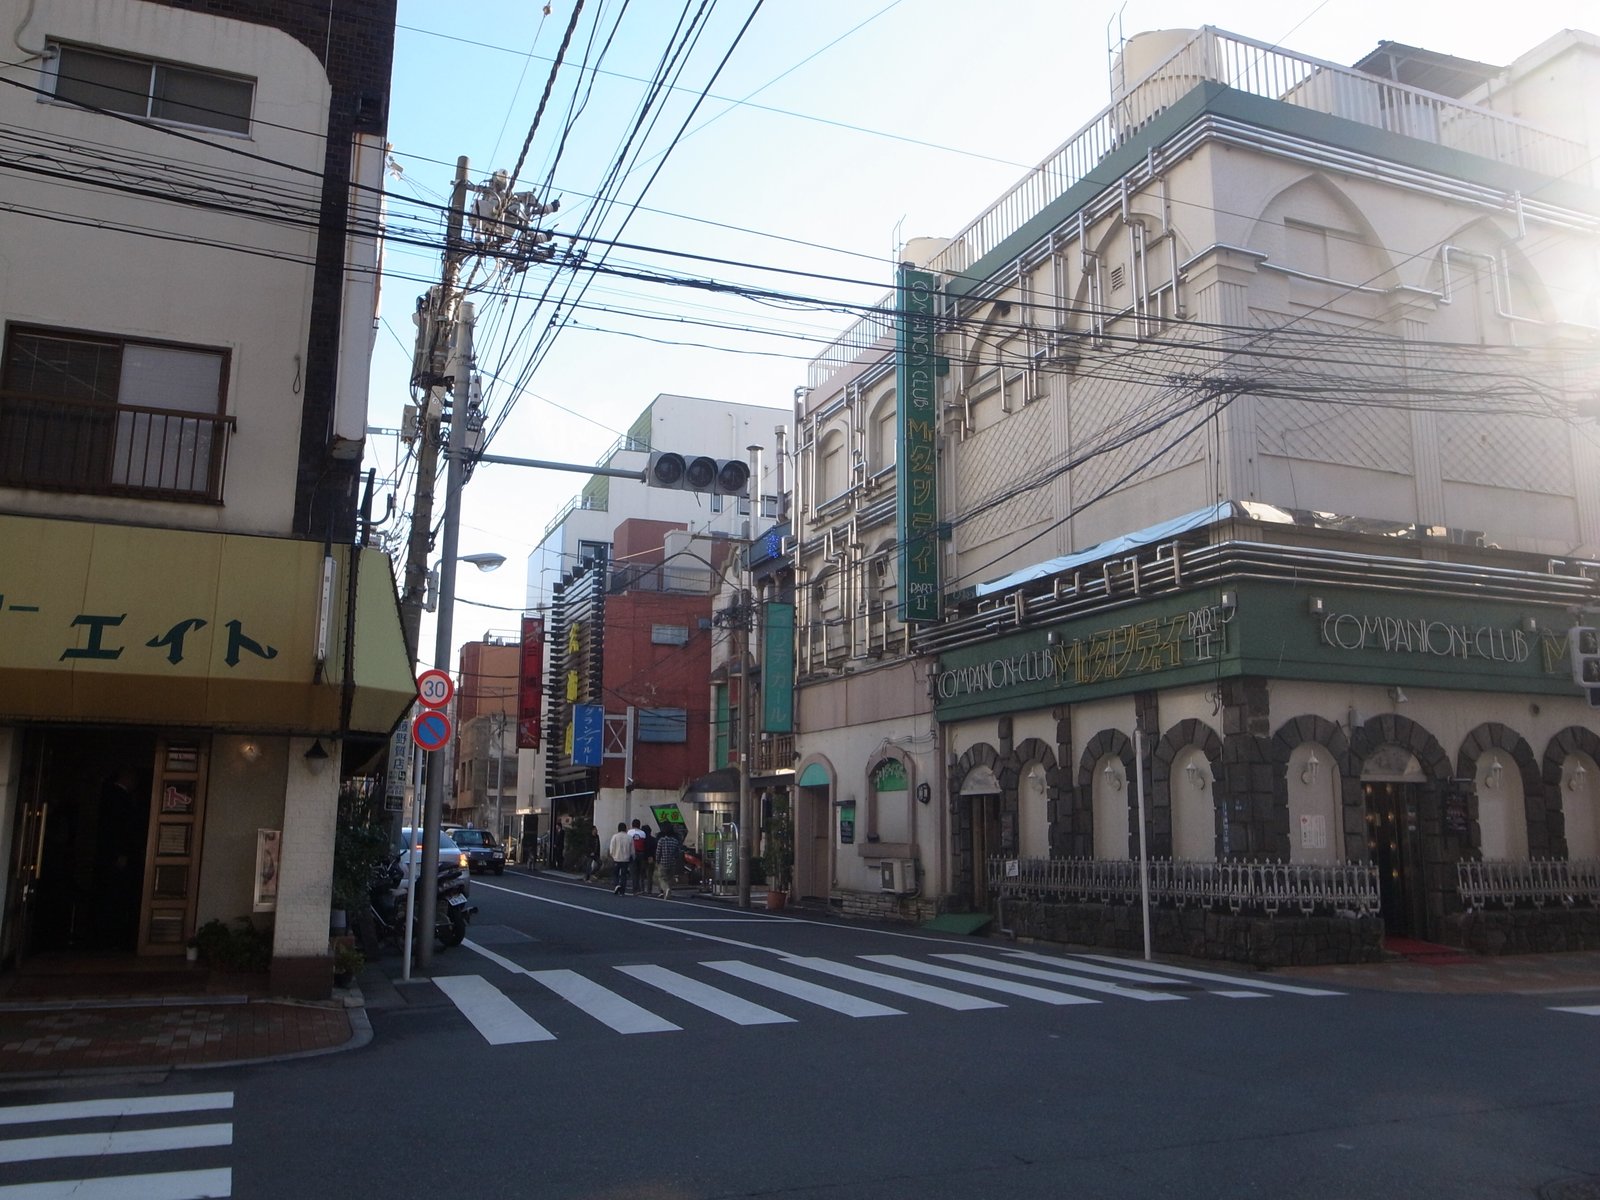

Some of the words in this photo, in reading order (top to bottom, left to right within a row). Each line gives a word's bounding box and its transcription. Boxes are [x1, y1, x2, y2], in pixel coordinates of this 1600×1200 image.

[911, 370, 929, 408] CLUB
[910, 582, 934, 594] PART
[1187, 606, 1220, 636] PART
[58, 613, 279, 668] エイト
[424, 680, 446, 698] 30
